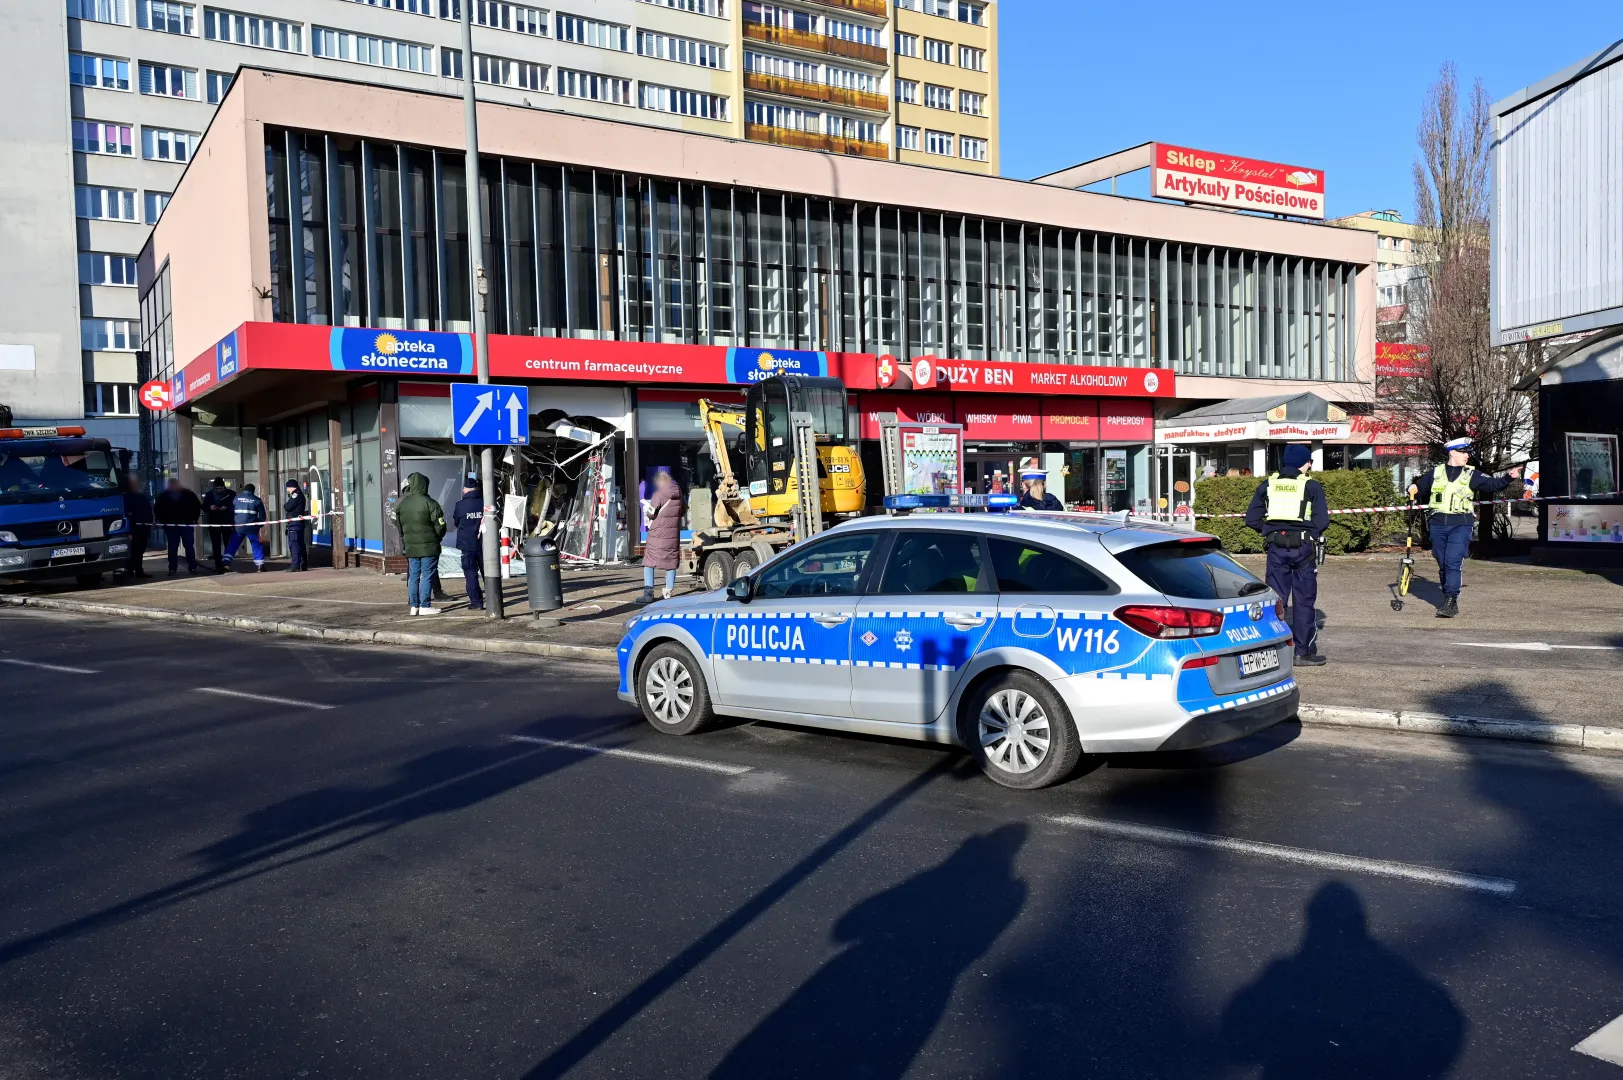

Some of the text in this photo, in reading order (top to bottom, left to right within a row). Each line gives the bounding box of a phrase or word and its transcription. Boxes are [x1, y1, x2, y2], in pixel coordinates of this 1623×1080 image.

[1166, 150, 1216, 172] Sklep
[1164, 173, 1318, 211] Artykuły Pościelowe
[386, 339, 436, 354] apteka
[361, 353, 448, 369] słoneczna
[525, 359, 683, 374] centrum farmaceutyczne
[765, 358, 801, 370] apteka
[936, 364, 1128, 387] DUŻY BEN MARKET ALKOHOLOWY
[917, 410, 946, 423] WÓDKI
[965, 413, 997, 424] WHISKY
[1012, 414, 1033, 424] PIWA
[1050, 415, 1090, 425] PROMOCJE
[1107, 416, 1145, 426] PAPIEROSY
[1163, 426, 1247, 440] manufaktura słodyczy
[1269, 425, 1338, 436] manufaktura słodyczy
[828, 465, 850, 473] JCB
[726, 624, 806, 651] POLICJA
[1056, 627, 1120, 654] W116
[1225, 625, 1262, 643] POLICJA
